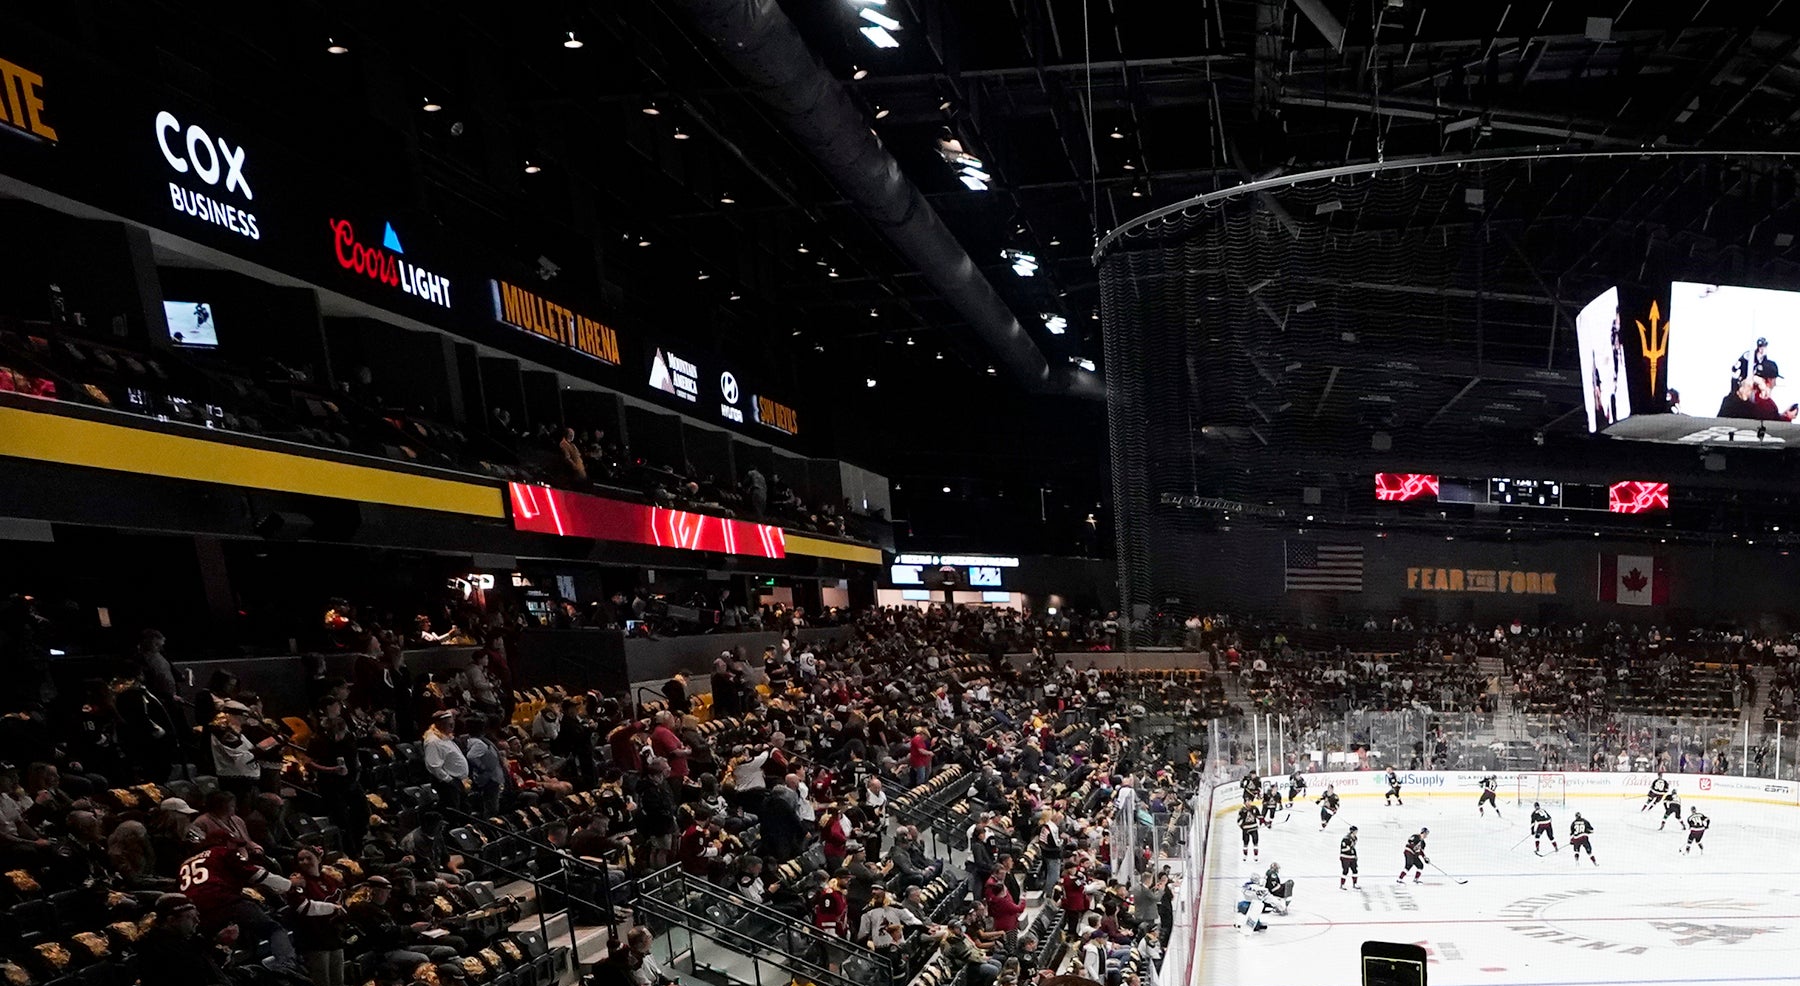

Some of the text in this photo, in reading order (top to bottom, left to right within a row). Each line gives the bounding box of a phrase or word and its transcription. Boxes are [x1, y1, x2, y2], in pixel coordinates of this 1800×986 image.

[156, 111, 253, 201] COX
[169, 182, 260, 240] BUSINESS
[330, 218, 451, 308] Coors LIGHT
[501, 280, 621, 365] MULLETT ARENA
[1407, 568, 1557, 594] FEAR THE FORK
[1586, 777, 1611, 786] Health
[179, 858, 209, 892] 35
